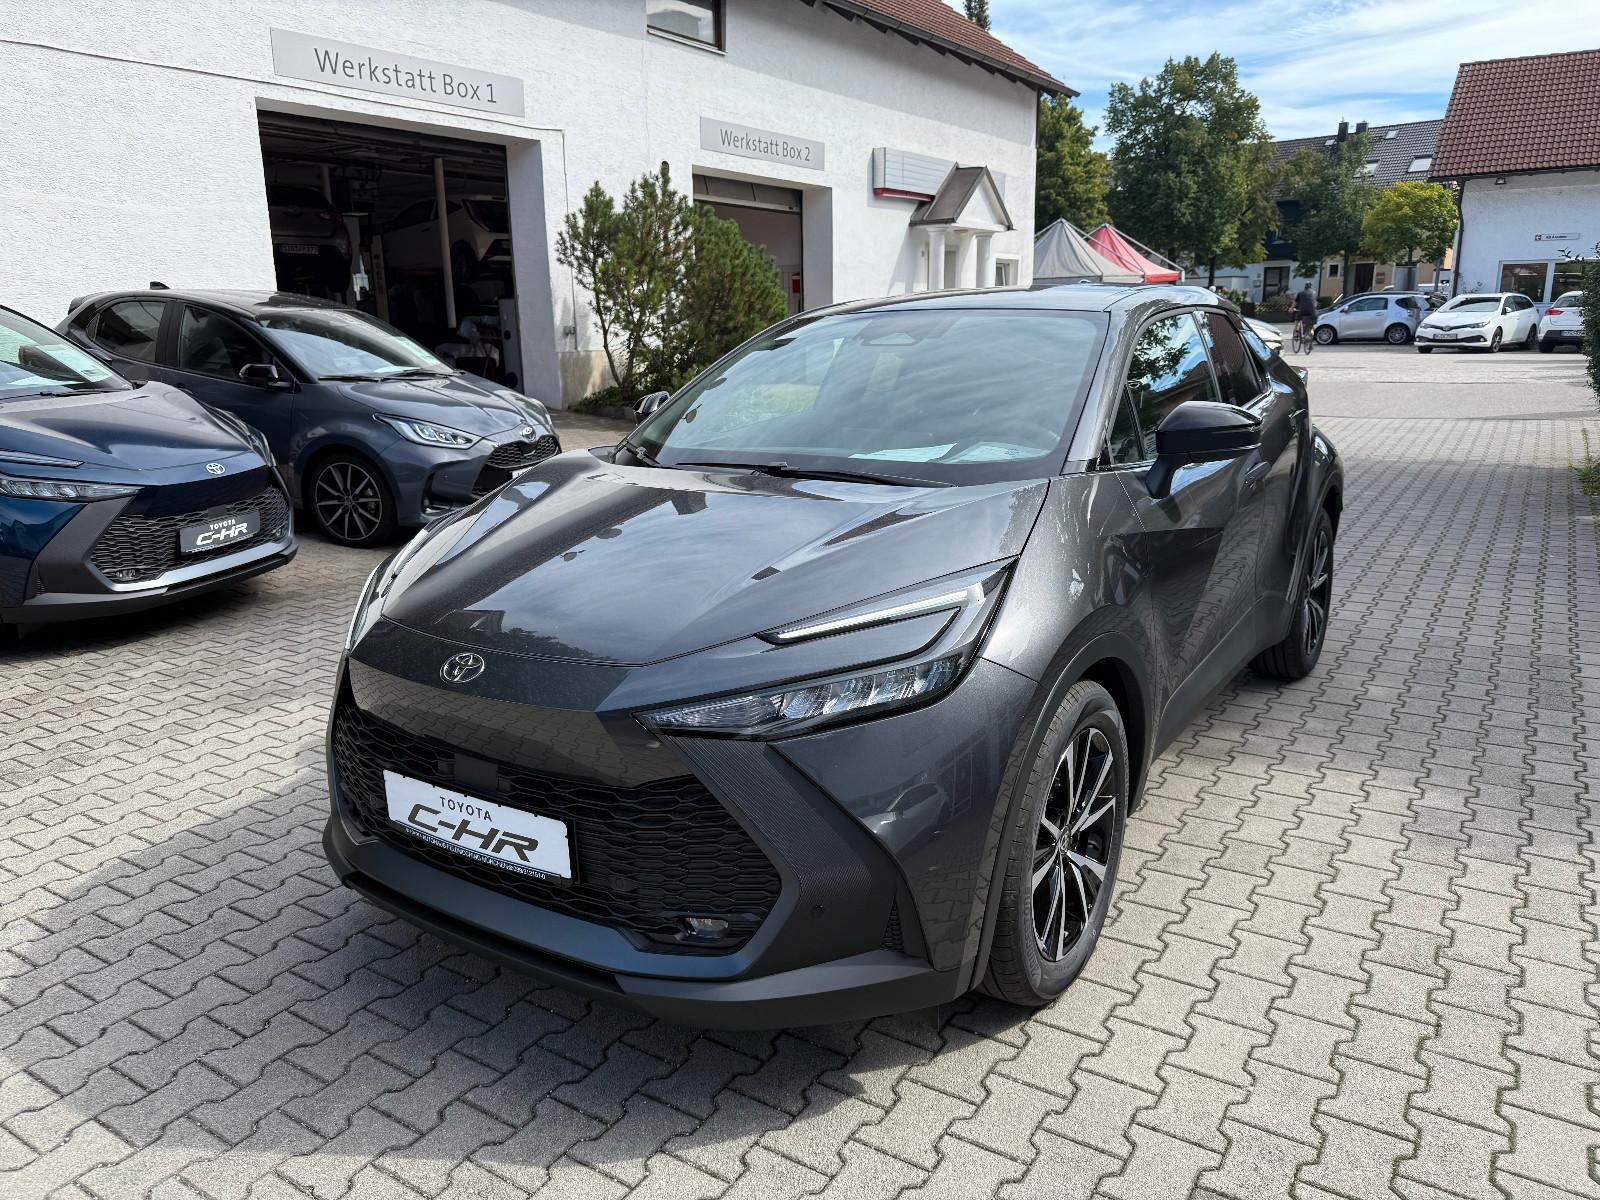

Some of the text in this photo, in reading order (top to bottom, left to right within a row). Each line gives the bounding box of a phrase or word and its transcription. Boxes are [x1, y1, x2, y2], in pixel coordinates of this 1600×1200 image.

[314, 47, 497, 104] Werkstatt Box 1
[719, 128, 811, 162] Werkstatt Box 2
[196, 522, 248, 546] C-HR
[209, 518, 236, 530] TOYOTA
[439, 796, 493, 823] TOYOTA
[407, 803, 539, 863] C-HR
